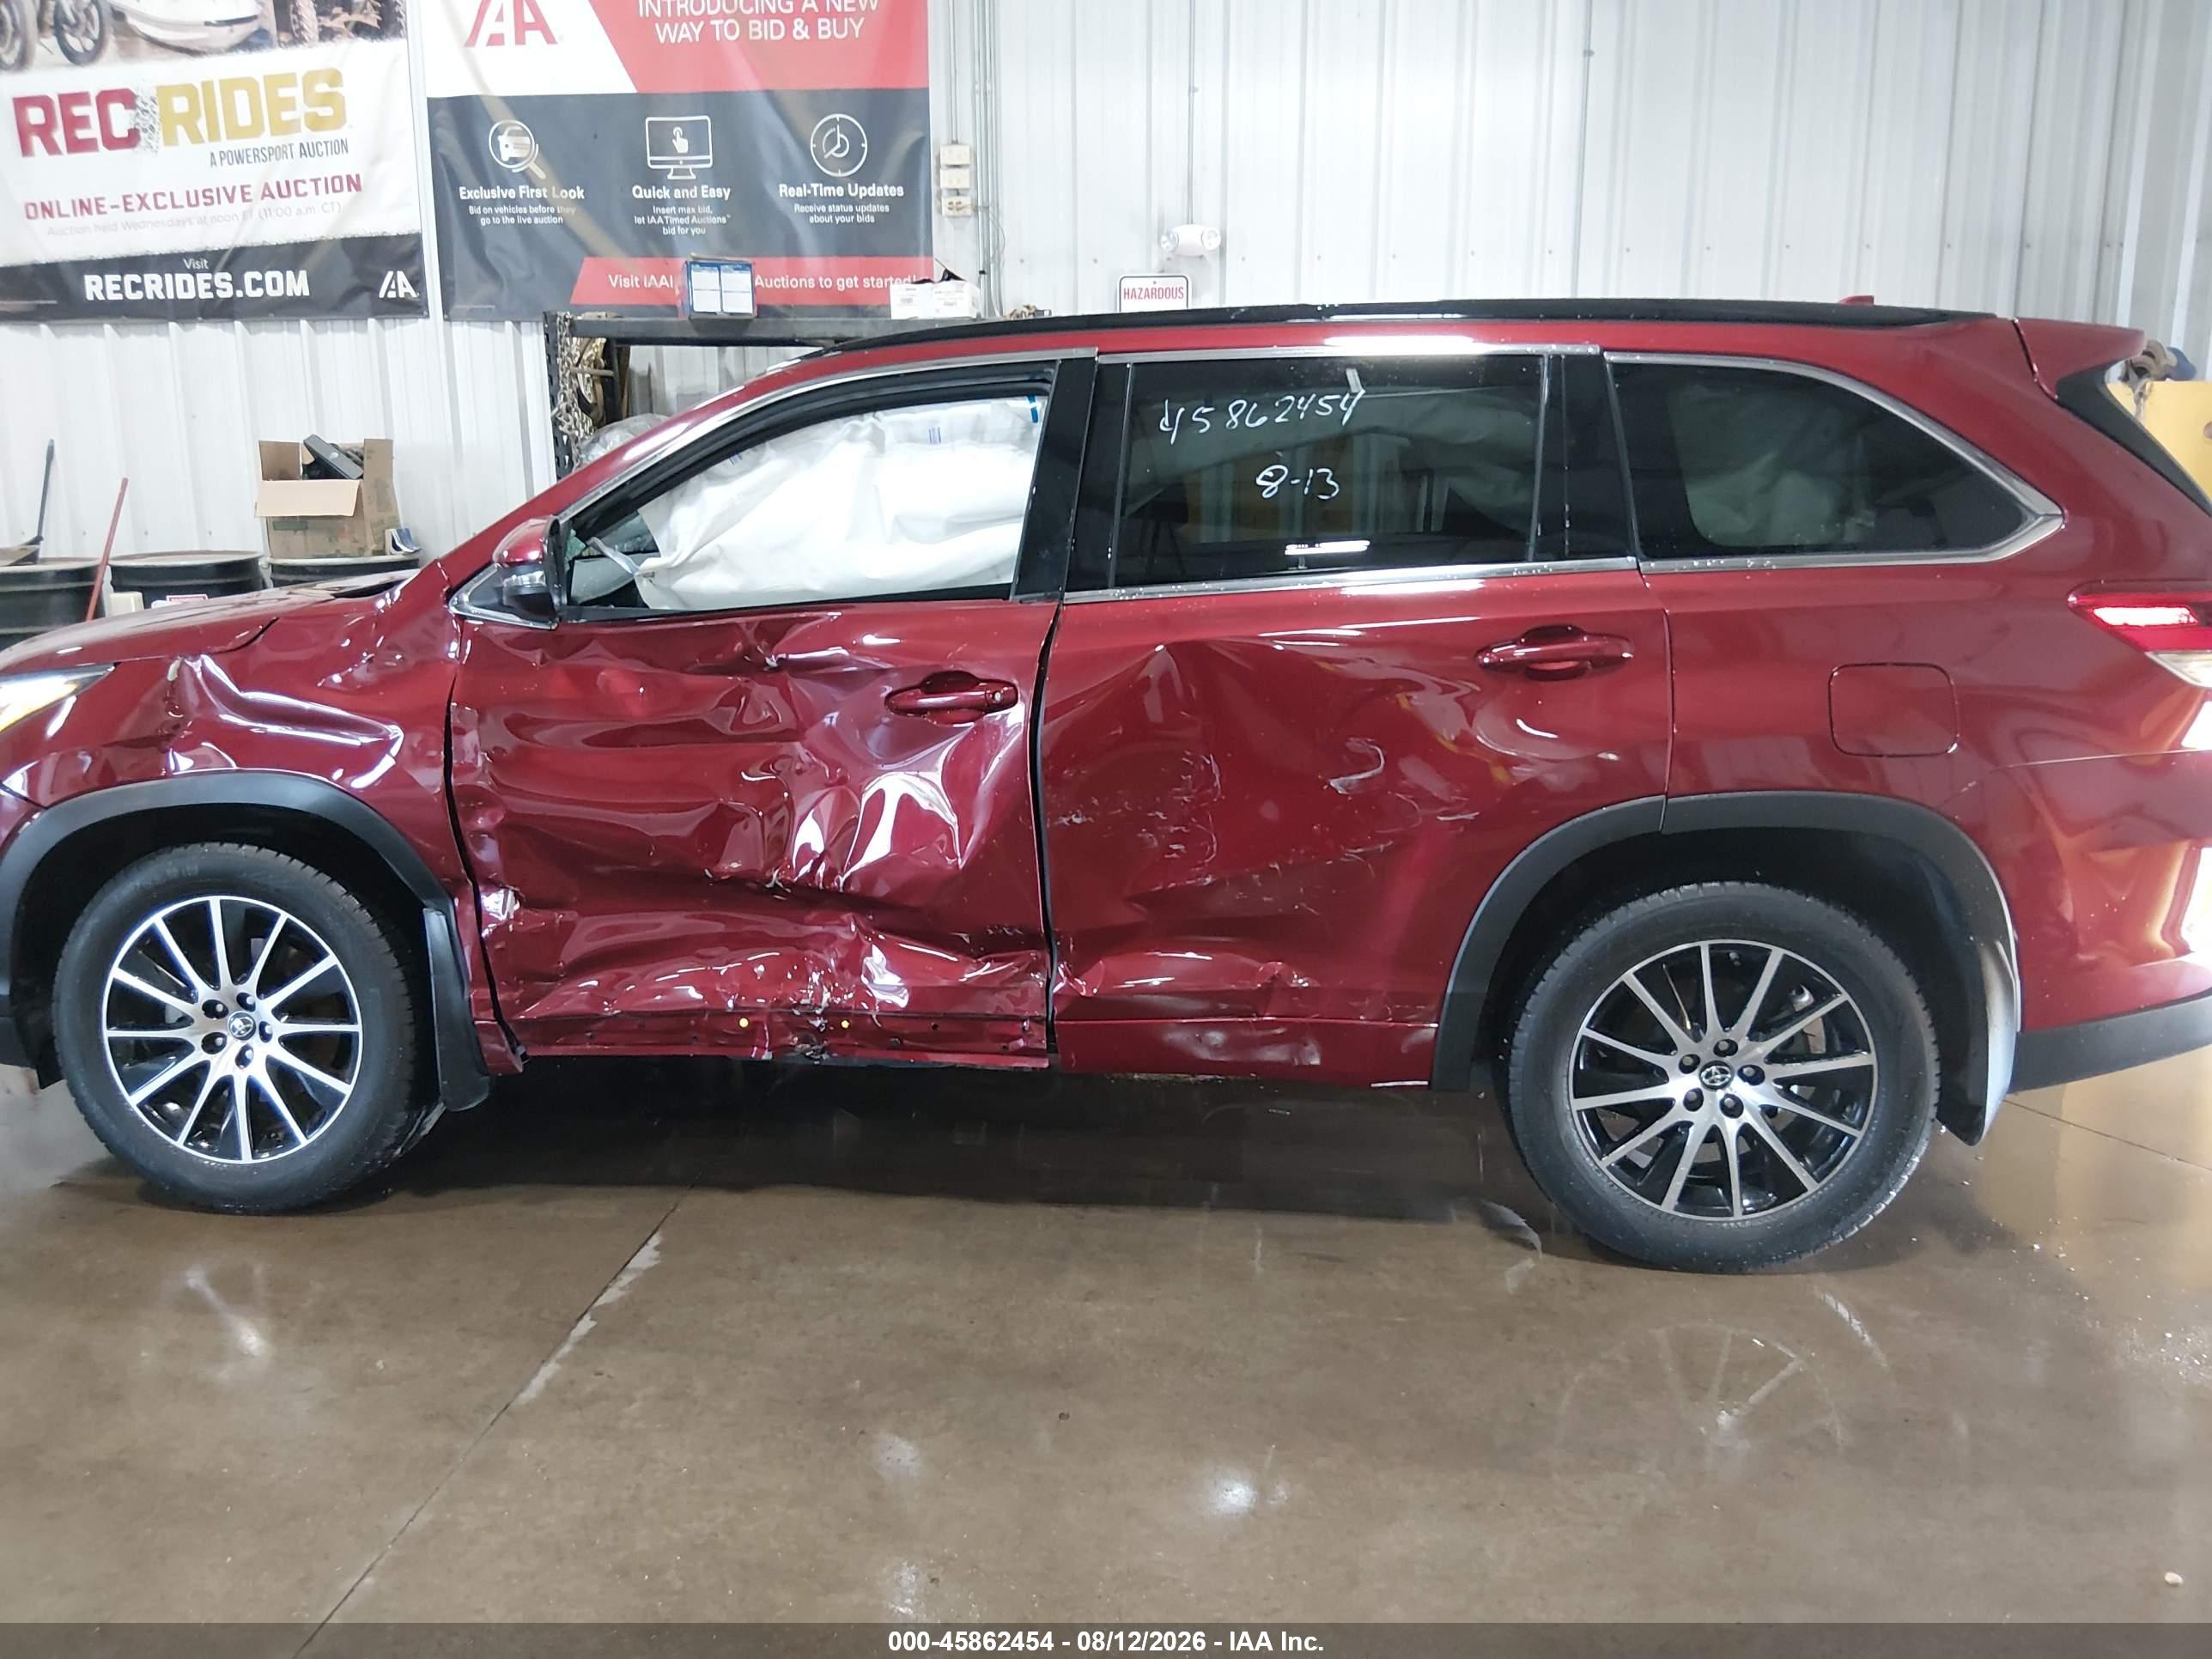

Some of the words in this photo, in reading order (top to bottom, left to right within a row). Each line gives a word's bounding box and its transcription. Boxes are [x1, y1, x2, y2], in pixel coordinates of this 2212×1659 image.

[638, 0, 794, 17] INTRODUCING
[801, 0, 819, 13] A
[826, 0, 879, 12] NEW
[654, 20, 705, 44] WAY
[709, 18, 740, 41] TO
[748, 19, 786, 41] BID
[792, 17, 811, 40] &
[817, 17, 866, 40] BUY
[12, 88, 142, 158] REC
[156, 68, 347, 147] RIDES
[210, 151, 218, 168] A
[219, 143, 295, 167] POWERSPORT
[299, 137, 349, 159] AUCTION
[24, 184, 253, 220] ONLINE-EXCLUSIVE
[260, 173, 363, 201] AUCTION
[459, 185, 516, 200] Exclusive
[518, 185, 549, 199] First
[551, 185, 585, 199] Look
[631, 185, 671, 199] Quick
[673, 185, 698, 199] and
[701, 185, 732, 201] Easy
[779, 183, 844, 198] Real-Time
[848, 183, 904, 198] Updates
[468, 205, 482, 215] Bid
[495, 204, 527, 214] vehicles
[529, 204, 556, 214] before
[653, 205, 676, 215] Insert
[678, 206, 696, 215] max
[794, 204, 826, 213] Receive
[828, 204, 854, 213] status
[855, 204, 890, 215] updates
[480, 216, 491, 227] go
[492, 216, 501, 225] to
[501, 215, 515, 225] the
[516, 215, 532, 224] live
[533, 215, 564, 225] auction
[634, 216, 645, 225] let
[647, 216, 665, 225] IAA
[665, 215, 690, 225] Timed
[809, 215, 833, 223] about
[835, 215, 854, 225] your
[856, 214, 876, 223] bids
[47, 223, 91, 237] Auction
[662, 226, 676, 235] bid
[677, 226, 690, 234] for
[690, 228, 706, 236] you
[183, 258, 210, 270] Visit
[84, 270, 310, 301] RECRIDES.COM
[608, 274, 641, 289] Visit
[754, 274, 815, 289] Auctions
[818, 275, 831, 289] to
[836, 275, 860, 292] get
[1123, 286, 1184, 300] HAZARDOUS
[1255, 464, 1340, 500] 8-13
